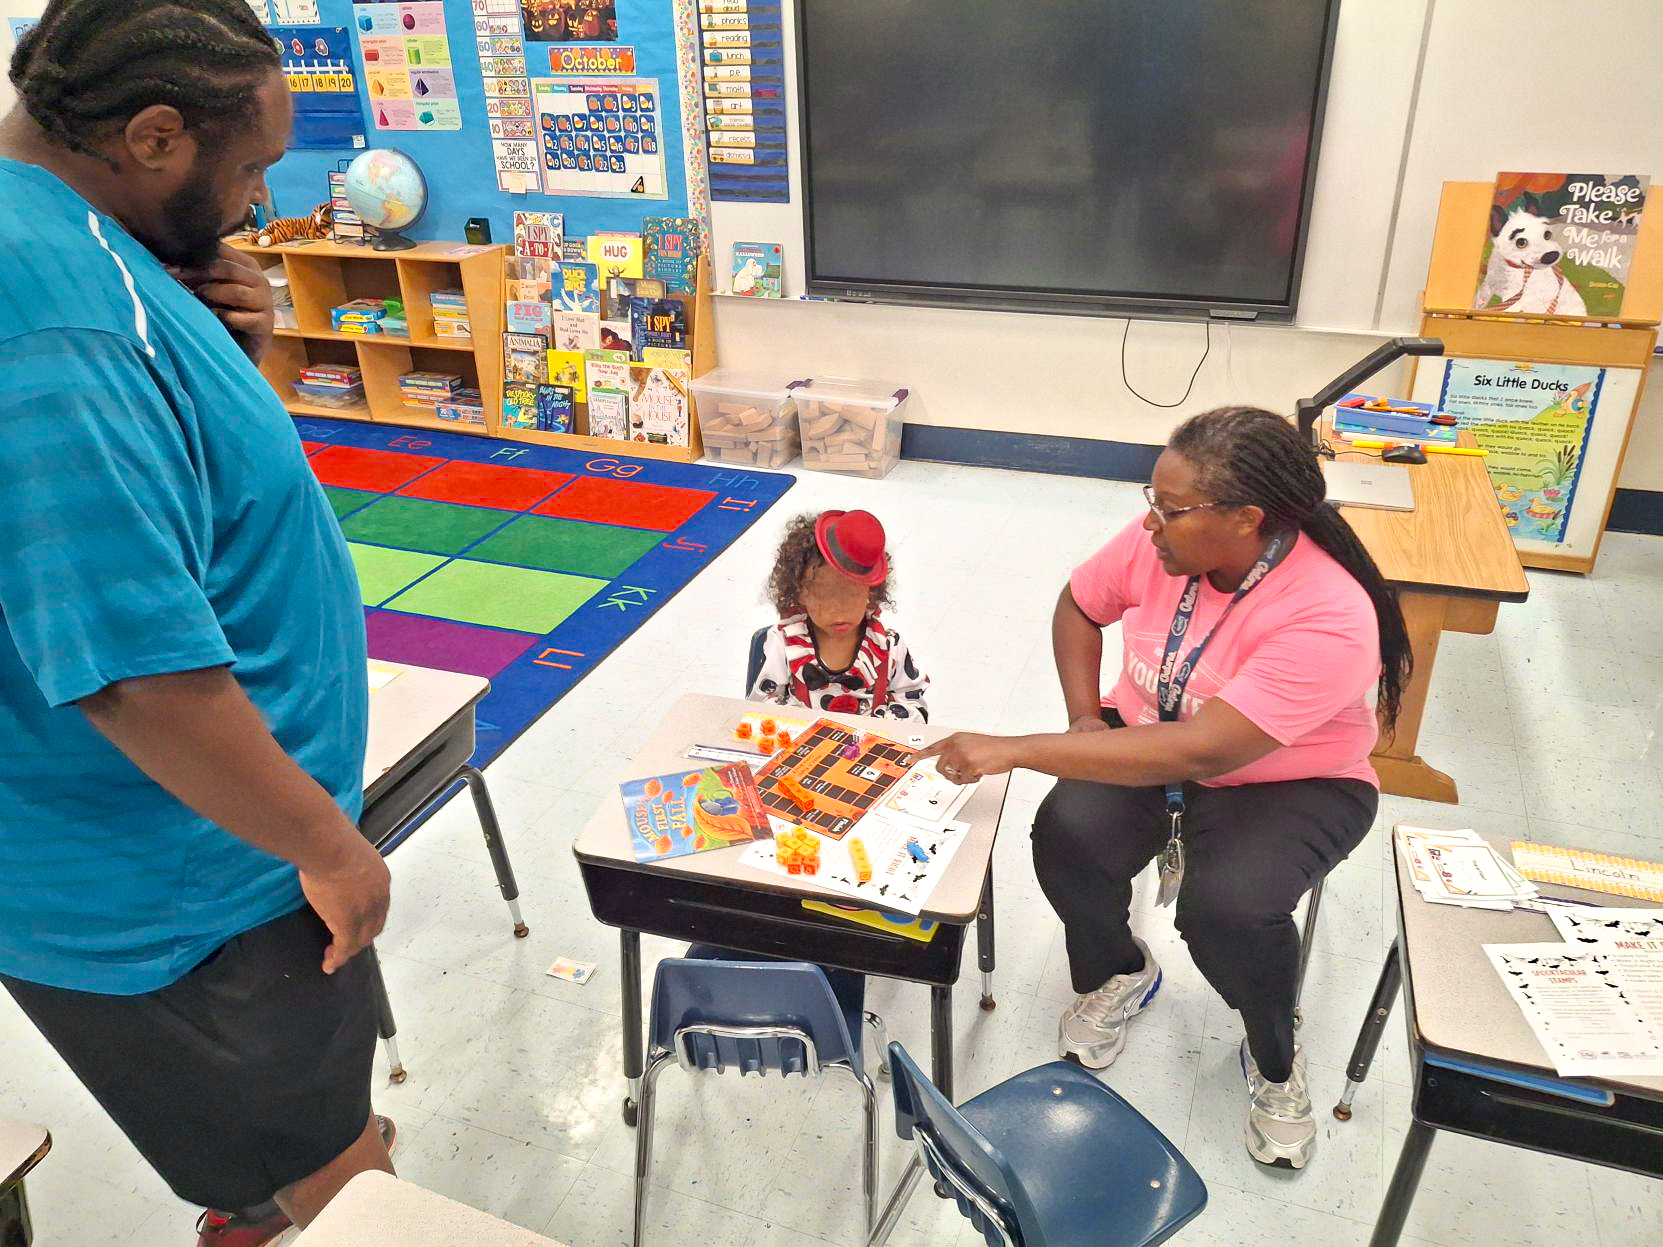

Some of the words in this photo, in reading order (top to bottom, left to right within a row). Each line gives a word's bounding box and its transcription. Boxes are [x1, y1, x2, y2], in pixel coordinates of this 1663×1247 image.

[473, 0, 484, 11] 70
[476, 21, 488, 31] 60
[721, 16, 747, 27] phonics
[721, 33, 748, 44] reading
[478, 41, 490, 52] 50
[561, 51, 623, 69] October
[726, 52, 744, 60] lunch
[290, 79, 297, 87] 16
[302, 79, 309, 87] 17
[315, 79, 323, 87] 18
[328, 79, 336, 87] 19
[341, 78, 352, 87] 20
[487, 103, 499, 113] 20
[730, 102, 742, 110] art
[491, 124, 500, 133] 10
[630, 122, 637, 132] 10
[551, 140, 558, 149] 12
[566, 140, 573, 150] 13
[581, 140, 588, 150] 14
[630, 142, 638, 152] 17
[648, 141, 656, 151] 18
[500, 161, 534, 170] SCHOOL?
[552, 158, 559, 168] 19
[567, 158, 575, 167] 20
[584, 159, 592, 169] 21
[616, 161, 624, 171] 23
[1568, 181, 1641, 204] Please
[1559, 203, 1612, 225] Take
[534, 226, 551, 241] SPY
[1563, 226, 1599, 247] Me
[1600, 230, 1619, 244] for
[1620, 236, 1627, 244] a
[665, 234, 682, 250] SPY
[604, 245, 628, 258] HUG
[1566, 246, 1623, 269] Walk
[654, 315, 672, 332] SPY
[509, 337, 541, 348] ANIMALIA
[1474, 374, 1492, 387] Six
[1496, 376, 1527, 389] Little
[1531, 378, 1569, 392] Ducks
[552, 400, 571, 409] NIGHT
[387, 435, 432, 450] Ee
[490, 447, 531, 461] Ff
[585, 458, 644, 479] Gg
[706, 471, 760, 490] Hh
[1127, 650, 1159, 694] YOU
[652, 803, 669, 831] FIRST
[672, 796, 689, 829] FALL
[1568, 858, 1640, 880] Lincoln
[1615, 941, 1644, 950] MAKE
